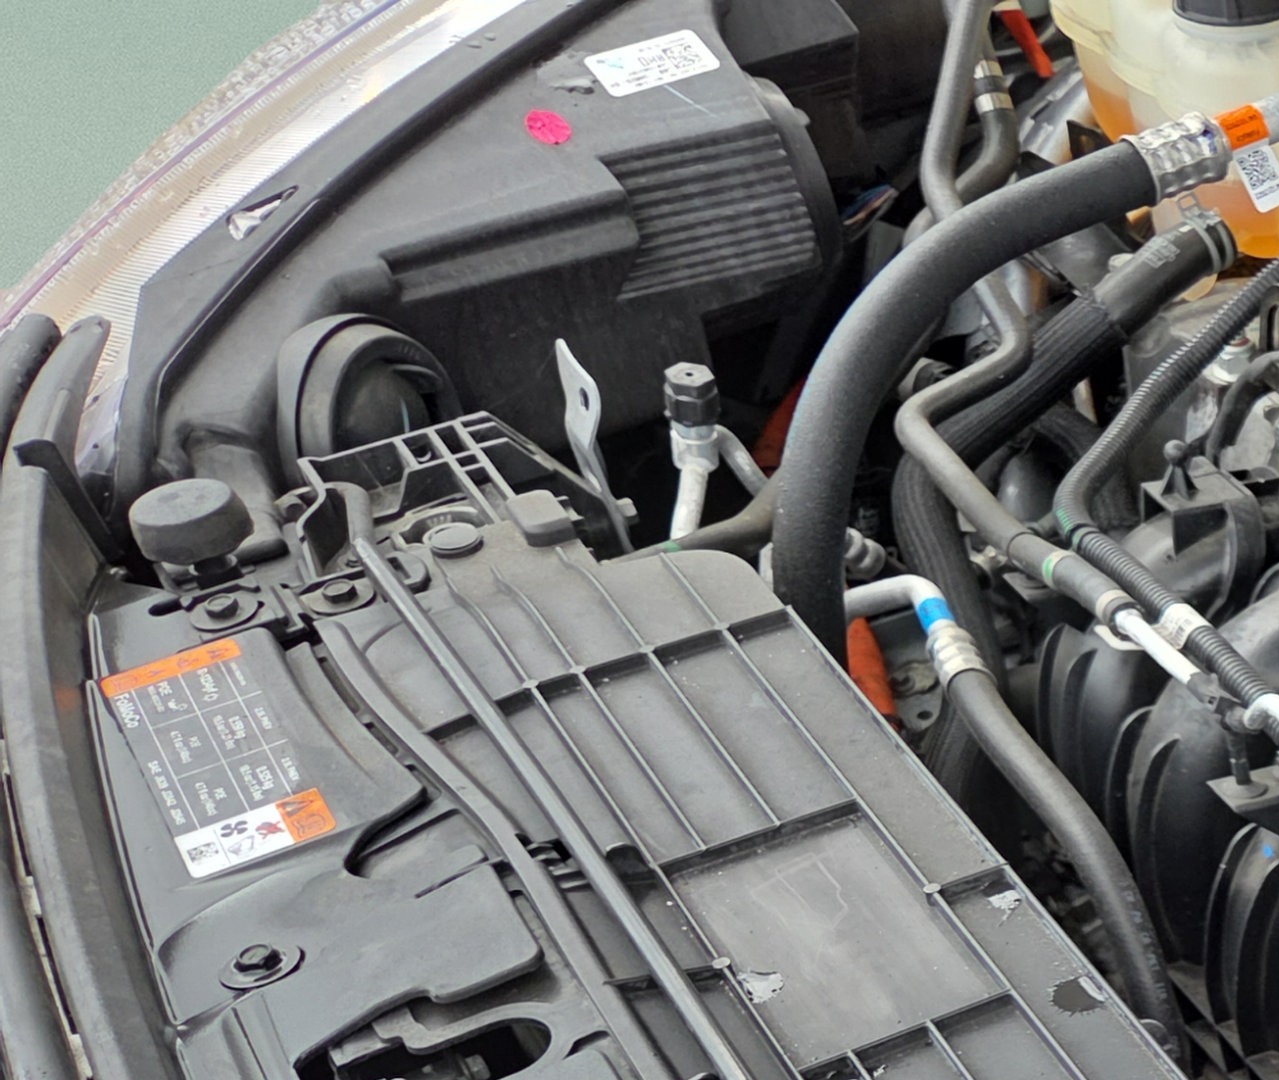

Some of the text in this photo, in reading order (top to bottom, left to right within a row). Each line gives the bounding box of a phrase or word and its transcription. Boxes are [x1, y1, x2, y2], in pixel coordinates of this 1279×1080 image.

[156, 680, 172, 696] POE
[113, 692, 142, 729] FoMoCo
[147, 759, 161, 774] SAE
